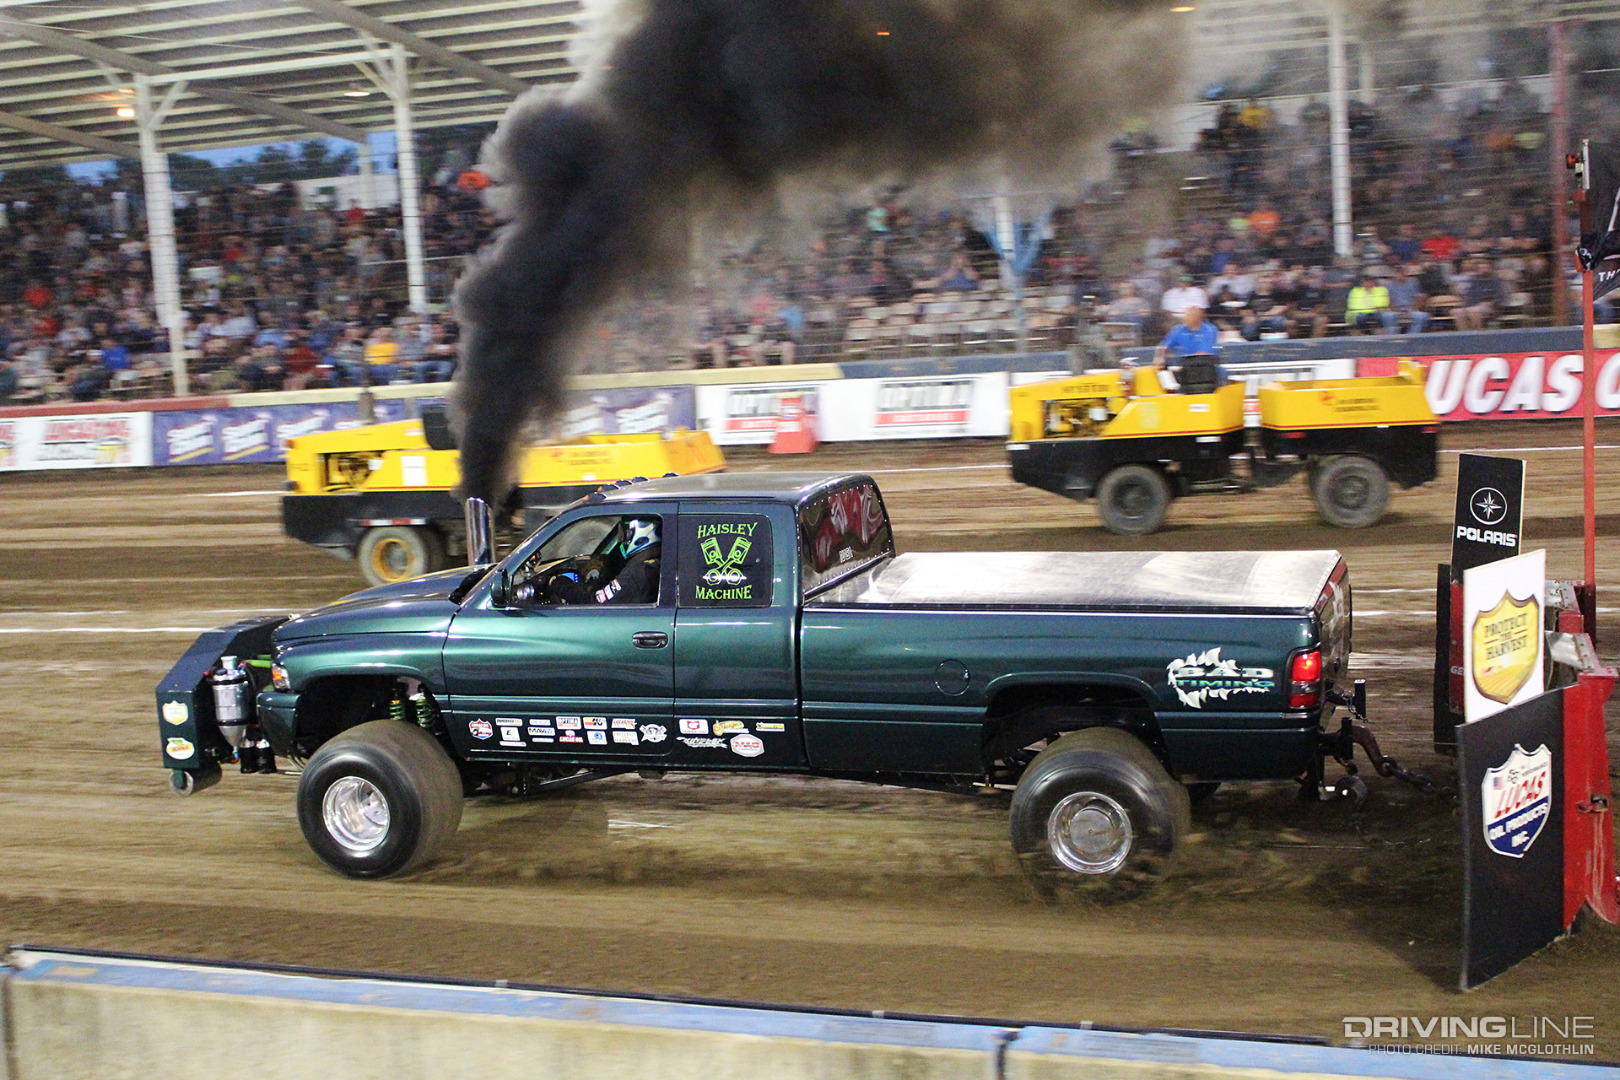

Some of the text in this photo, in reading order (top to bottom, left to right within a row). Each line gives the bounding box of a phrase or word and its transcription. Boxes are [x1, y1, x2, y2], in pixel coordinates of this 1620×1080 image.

[1424, 354, 1584, 415] UCAS
[697, 522, 758, 539] HAISLEY
[1457, 526, 1516, 547] POLARIS
[695, 585, 752, 599] MACHINE
[1485, 613, 1527, 638] PROTECT
[1486, 635, 1527, 660] HARVEST
[1176, 679, 1275, 688] TIMING
[1494, 771, 1546, 818] LUCAS
[1489, 825, 1506, 840] OIL
